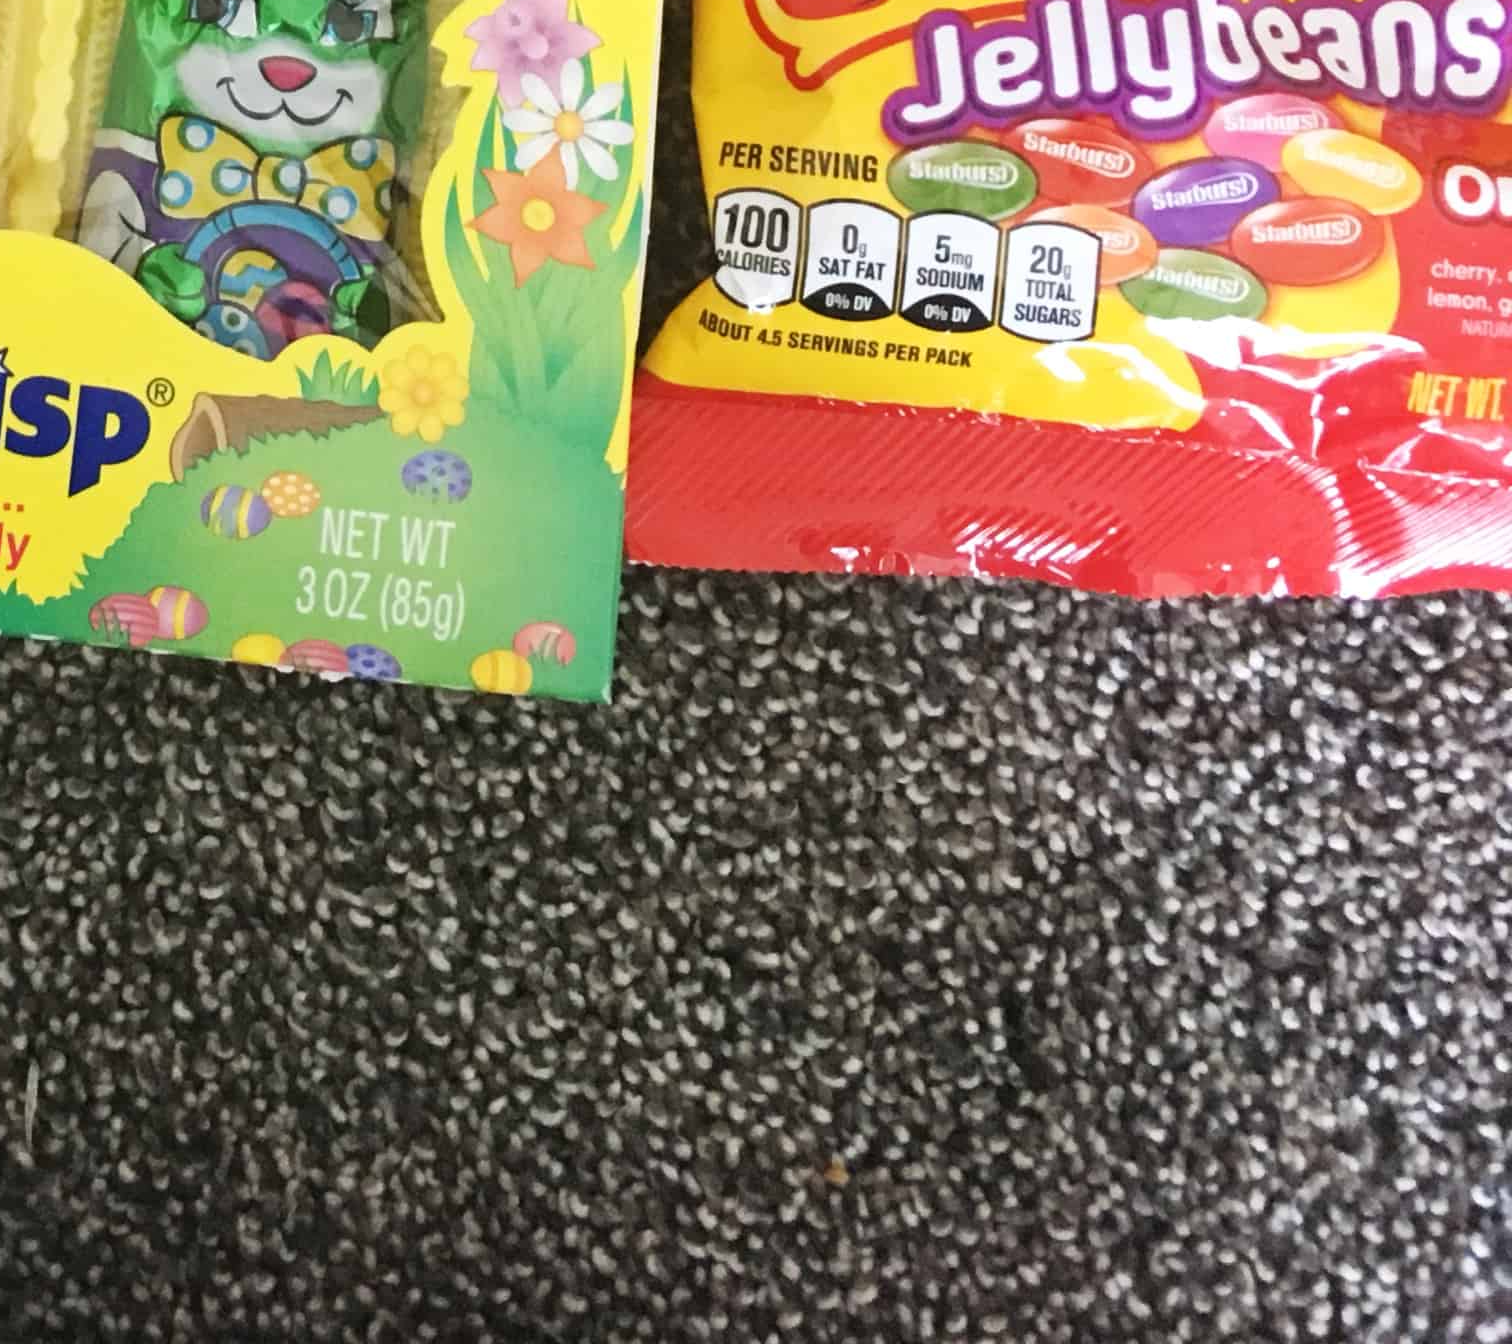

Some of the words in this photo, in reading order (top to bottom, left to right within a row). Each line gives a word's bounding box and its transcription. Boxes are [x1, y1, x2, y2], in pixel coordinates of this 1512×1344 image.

[719, 141, 762, 170] PER
[769, 145, 879, 184] SERVING
[723, 203, 790, 253] 100
[715, 248, 791, 277] CALORIES
[818, 256, 851, 277] SAT
[855, 260, 887, 281] FAT
[916, 267, 984, 292] SODIUM
[1025, 278, 1076, 302] TOTAL
[824, 292, 850, 310] 0%
[853, 295, 874, 312] DV
[923, 303, 949, 321] 0%
[951, 306, 973, 324] DV
[1013, 303, 1082, 328] SUGARS
[698, 308, 753, 343] ABOUT
[757, 328, 783, 347] 4.5
[787, 331, 879, 359] SERVINGS
[884, 342, 921, 362] PER
[925, 347, 974, 369] PACK
[1406, 370, 1464, 418] NET
[320, 506, 388, 560] NET
[400, 517, 457, 569] WT
[296, 567, 316, 615] 3
[323, 569, 370, 621] OZ
[379, 578, 466, 640] (85g)
